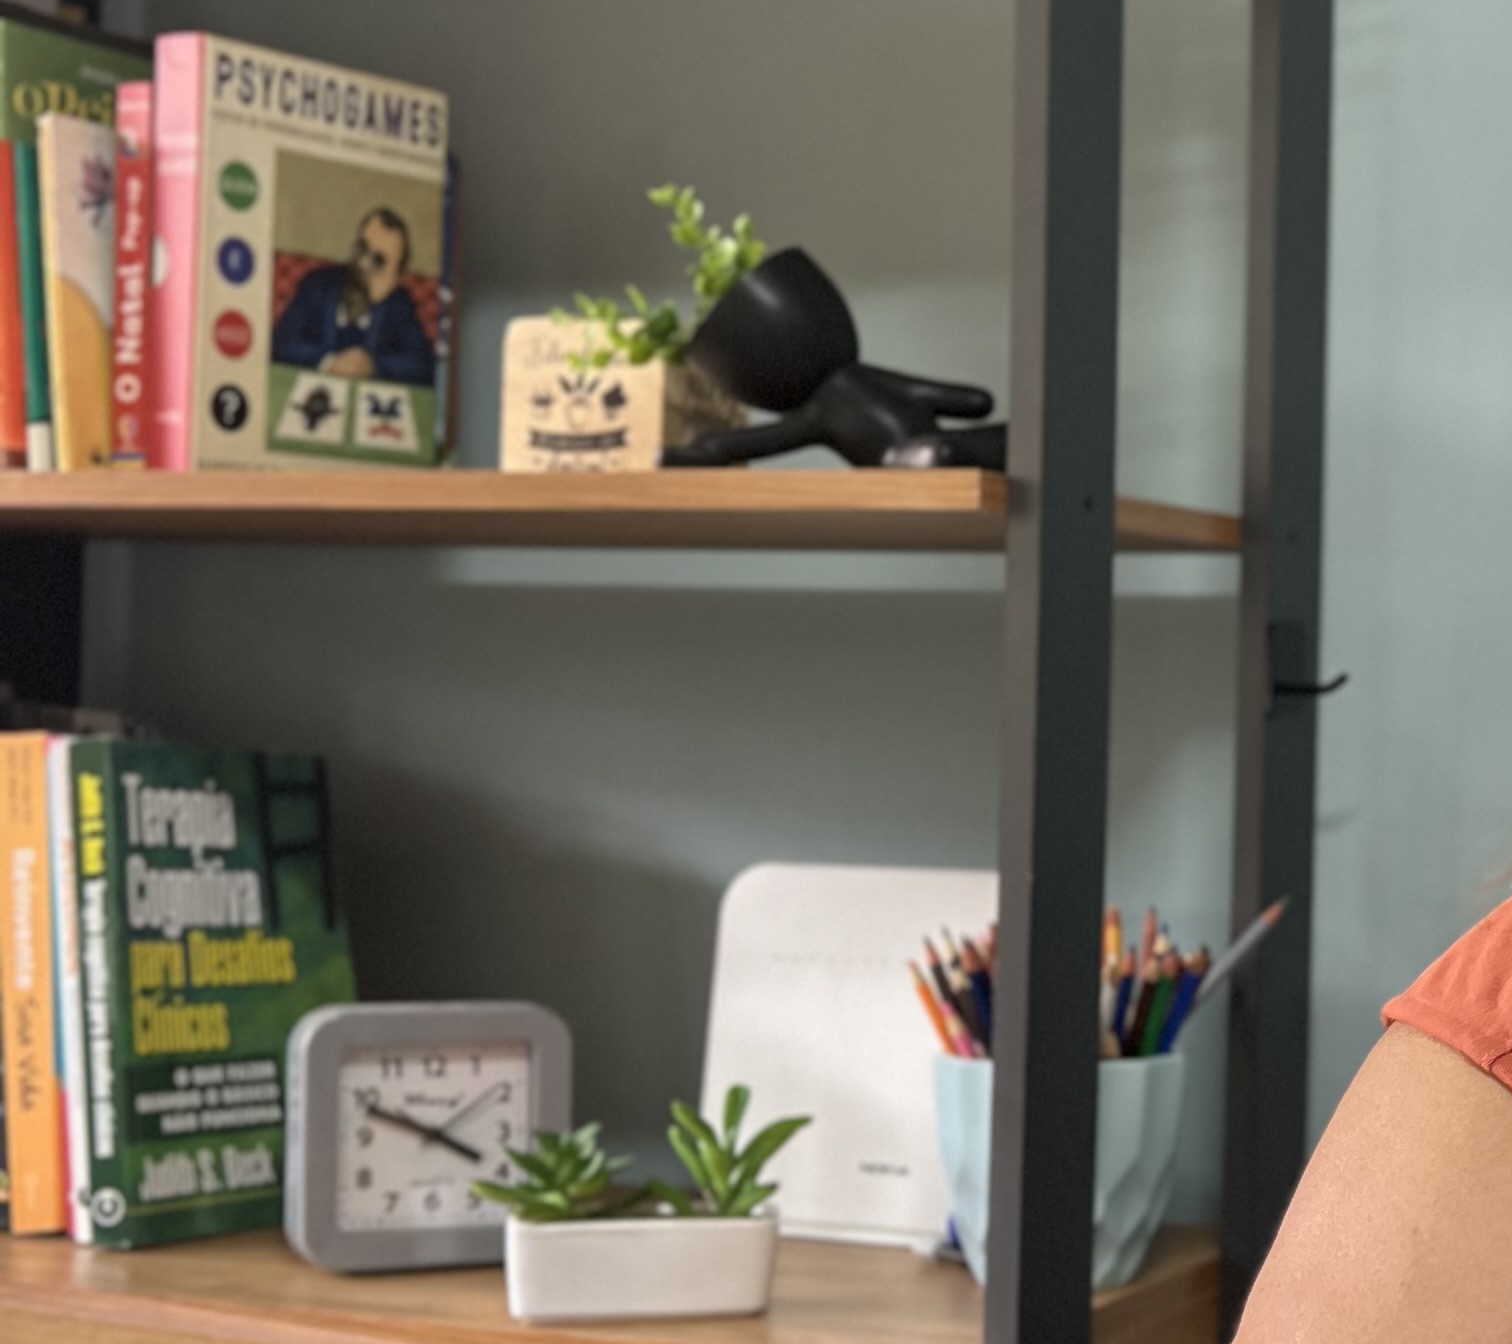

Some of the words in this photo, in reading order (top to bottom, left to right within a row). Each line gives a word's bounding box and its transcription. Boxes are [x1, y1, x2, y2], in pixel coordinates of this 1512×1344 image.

[215, 49, 441, 149] PSYCHOGAMES
[115, 264, 143, 364] Natal
[114, 372, 142, 404] O
[120, 771, 237, 866] Terapia
[11, 847, 36, 990] Reinvente
[125, 854, 263, 939] Cognitiva
[129, 940, 187, 994] para
[187, 927, 297, 988] Desafios
[132, 991, 232, 1056] Clínicos
[354, 1086, 381, 1109] 10
[498, 1080, 512, 1104] 2
[380, 1056, 404, 1079] 11
[422, 1056, 448, 1078] 12
[470, 1054, 482, 1076] 1
[356, 1124, 374, 1148] 9
[497, 1121, 511, 1145] 3
[138, 1152, 197, 1203] Judith
[221, 1143, 277, 1190] Beck
[383, 1190, 400, 1214] 7
[423, 1190, 442, 1213] 6
